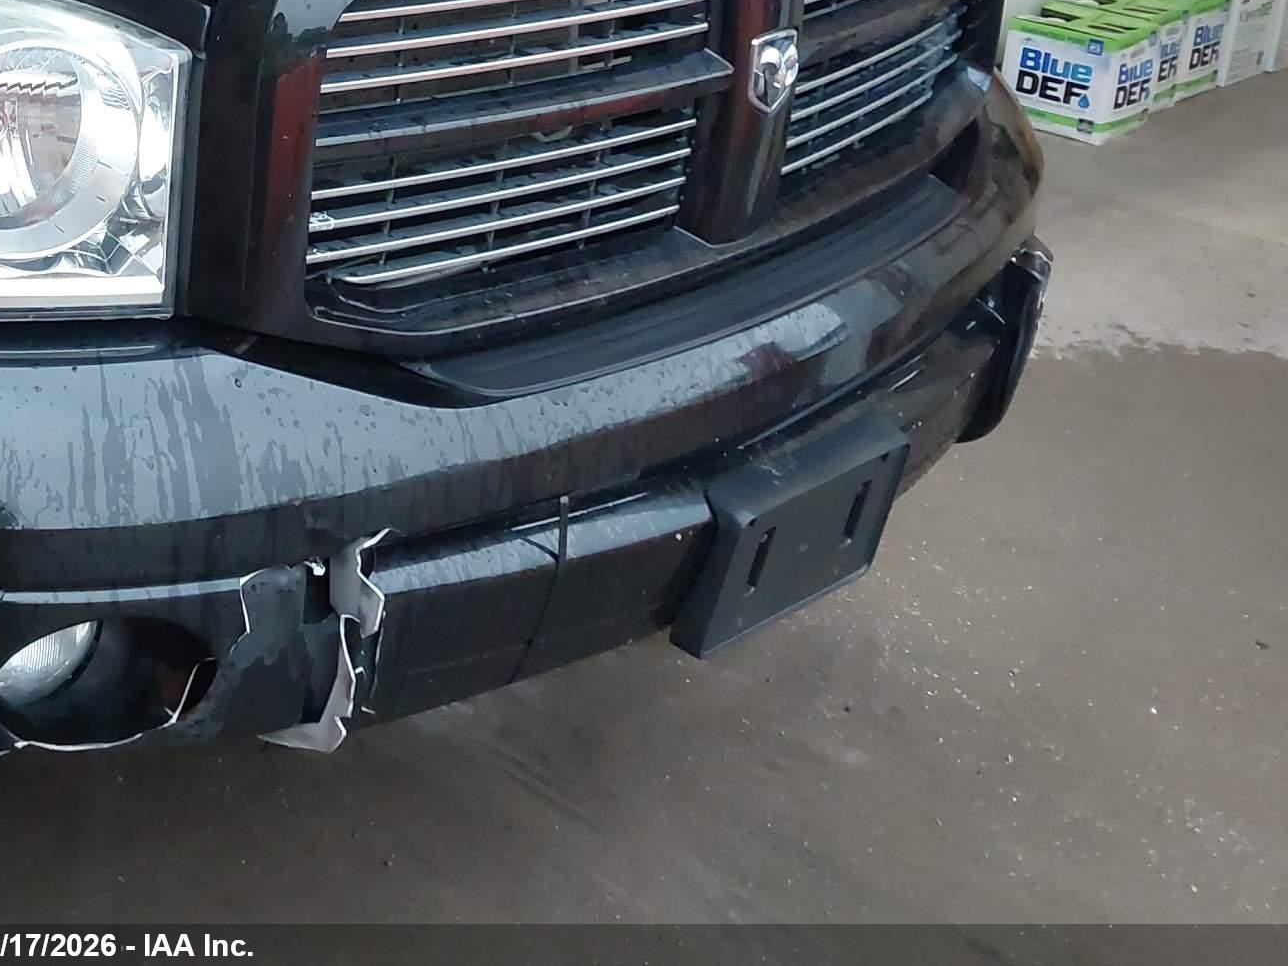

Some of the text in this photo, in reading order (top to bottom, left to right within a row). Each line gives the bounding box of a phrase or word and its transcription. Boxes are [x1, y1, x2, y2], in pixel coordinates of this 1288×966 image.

[1020, 47, 1093, 83] Blue
[1160, 41, 1181, 59] lue
[1117, 59, 1153, 85] Blue
[1158, 55, 1178, 82] EF
[1016, 69, 1090, 105] DEF
[1113, 77, 1152, 110] DEF
